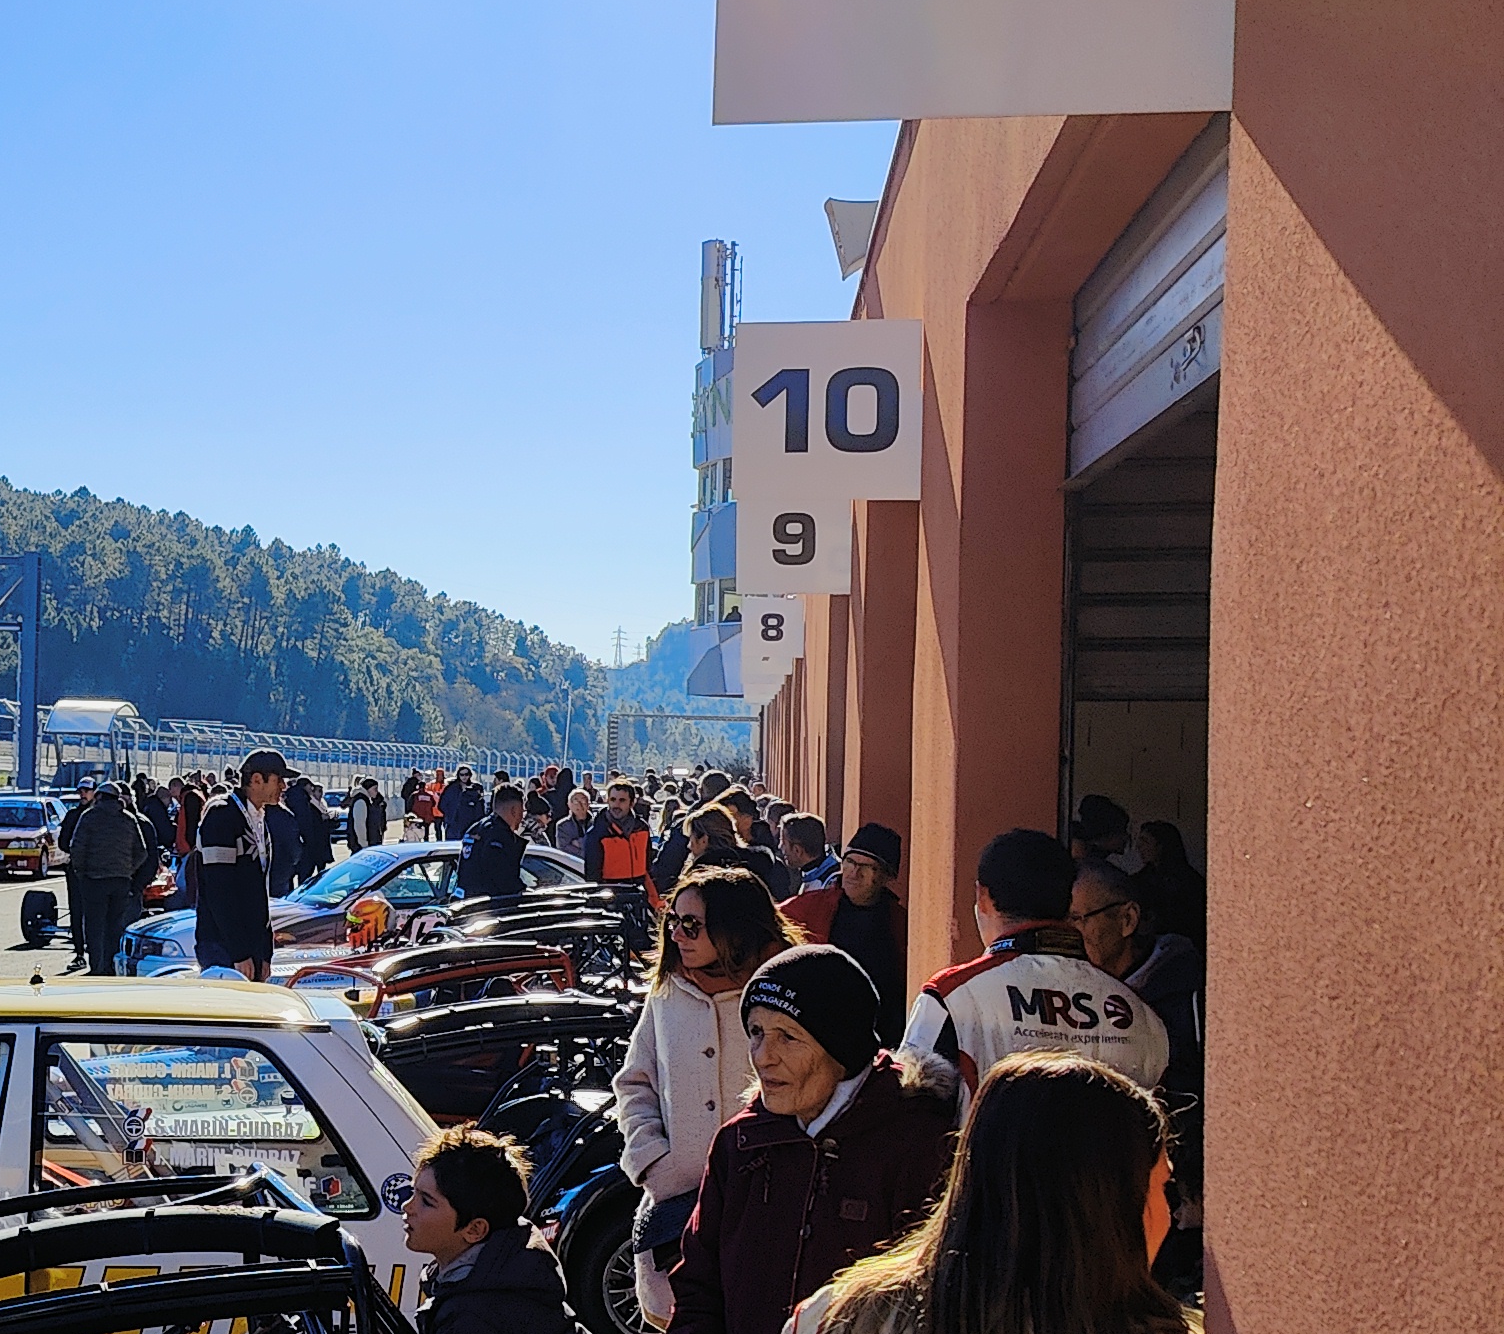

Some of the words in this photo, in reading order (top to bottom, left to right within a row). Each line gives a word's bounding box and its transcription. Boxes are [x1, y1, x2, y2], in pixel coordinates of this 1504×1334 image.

[750, 366, 900, 454] 10
[771, 511, 817, 566] 9
[760, 612, 785, 642] 8
[1005, 984, 1100, 1030] MRS
